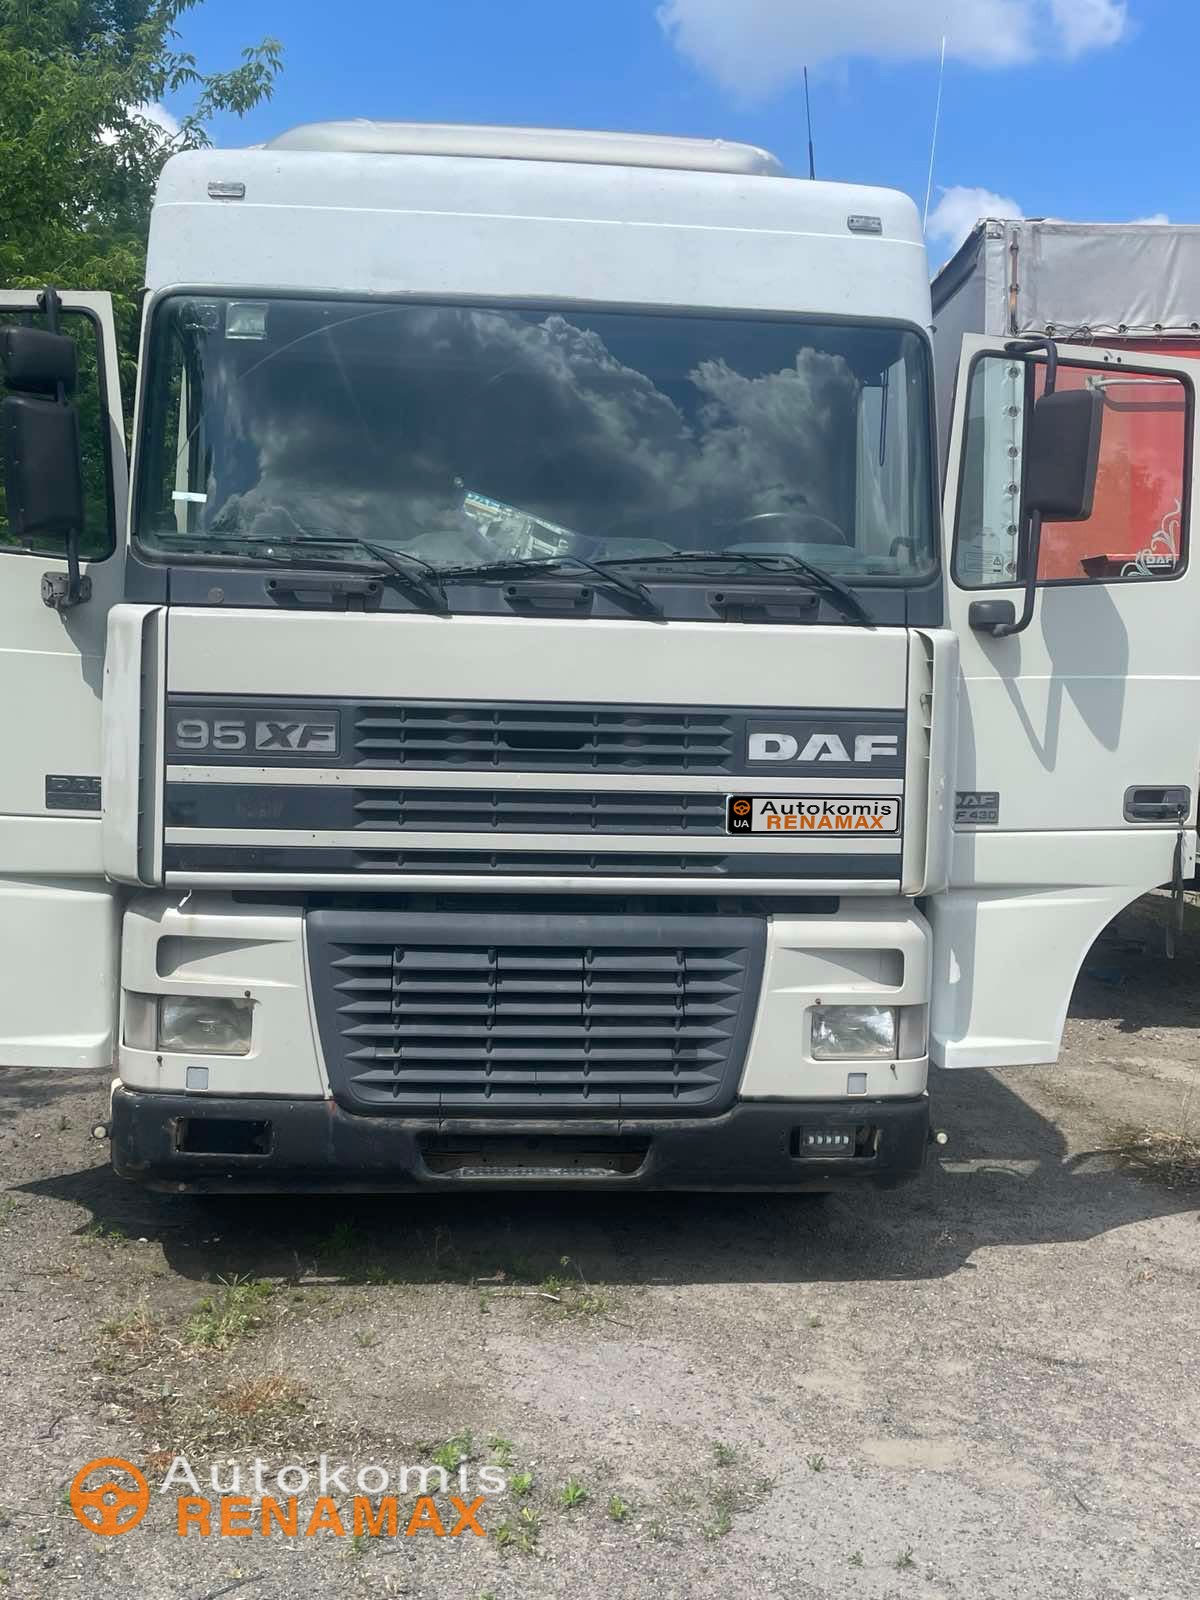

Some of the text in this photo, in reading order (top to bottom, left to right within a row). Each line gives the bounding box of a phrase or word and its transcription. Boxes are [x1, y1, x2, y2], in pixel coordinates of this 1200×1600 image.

[1146, 555, 1172, 564] DAF
[176, 719, 335, 750] 95 XF
[748, 732, 898, 762] DAF
